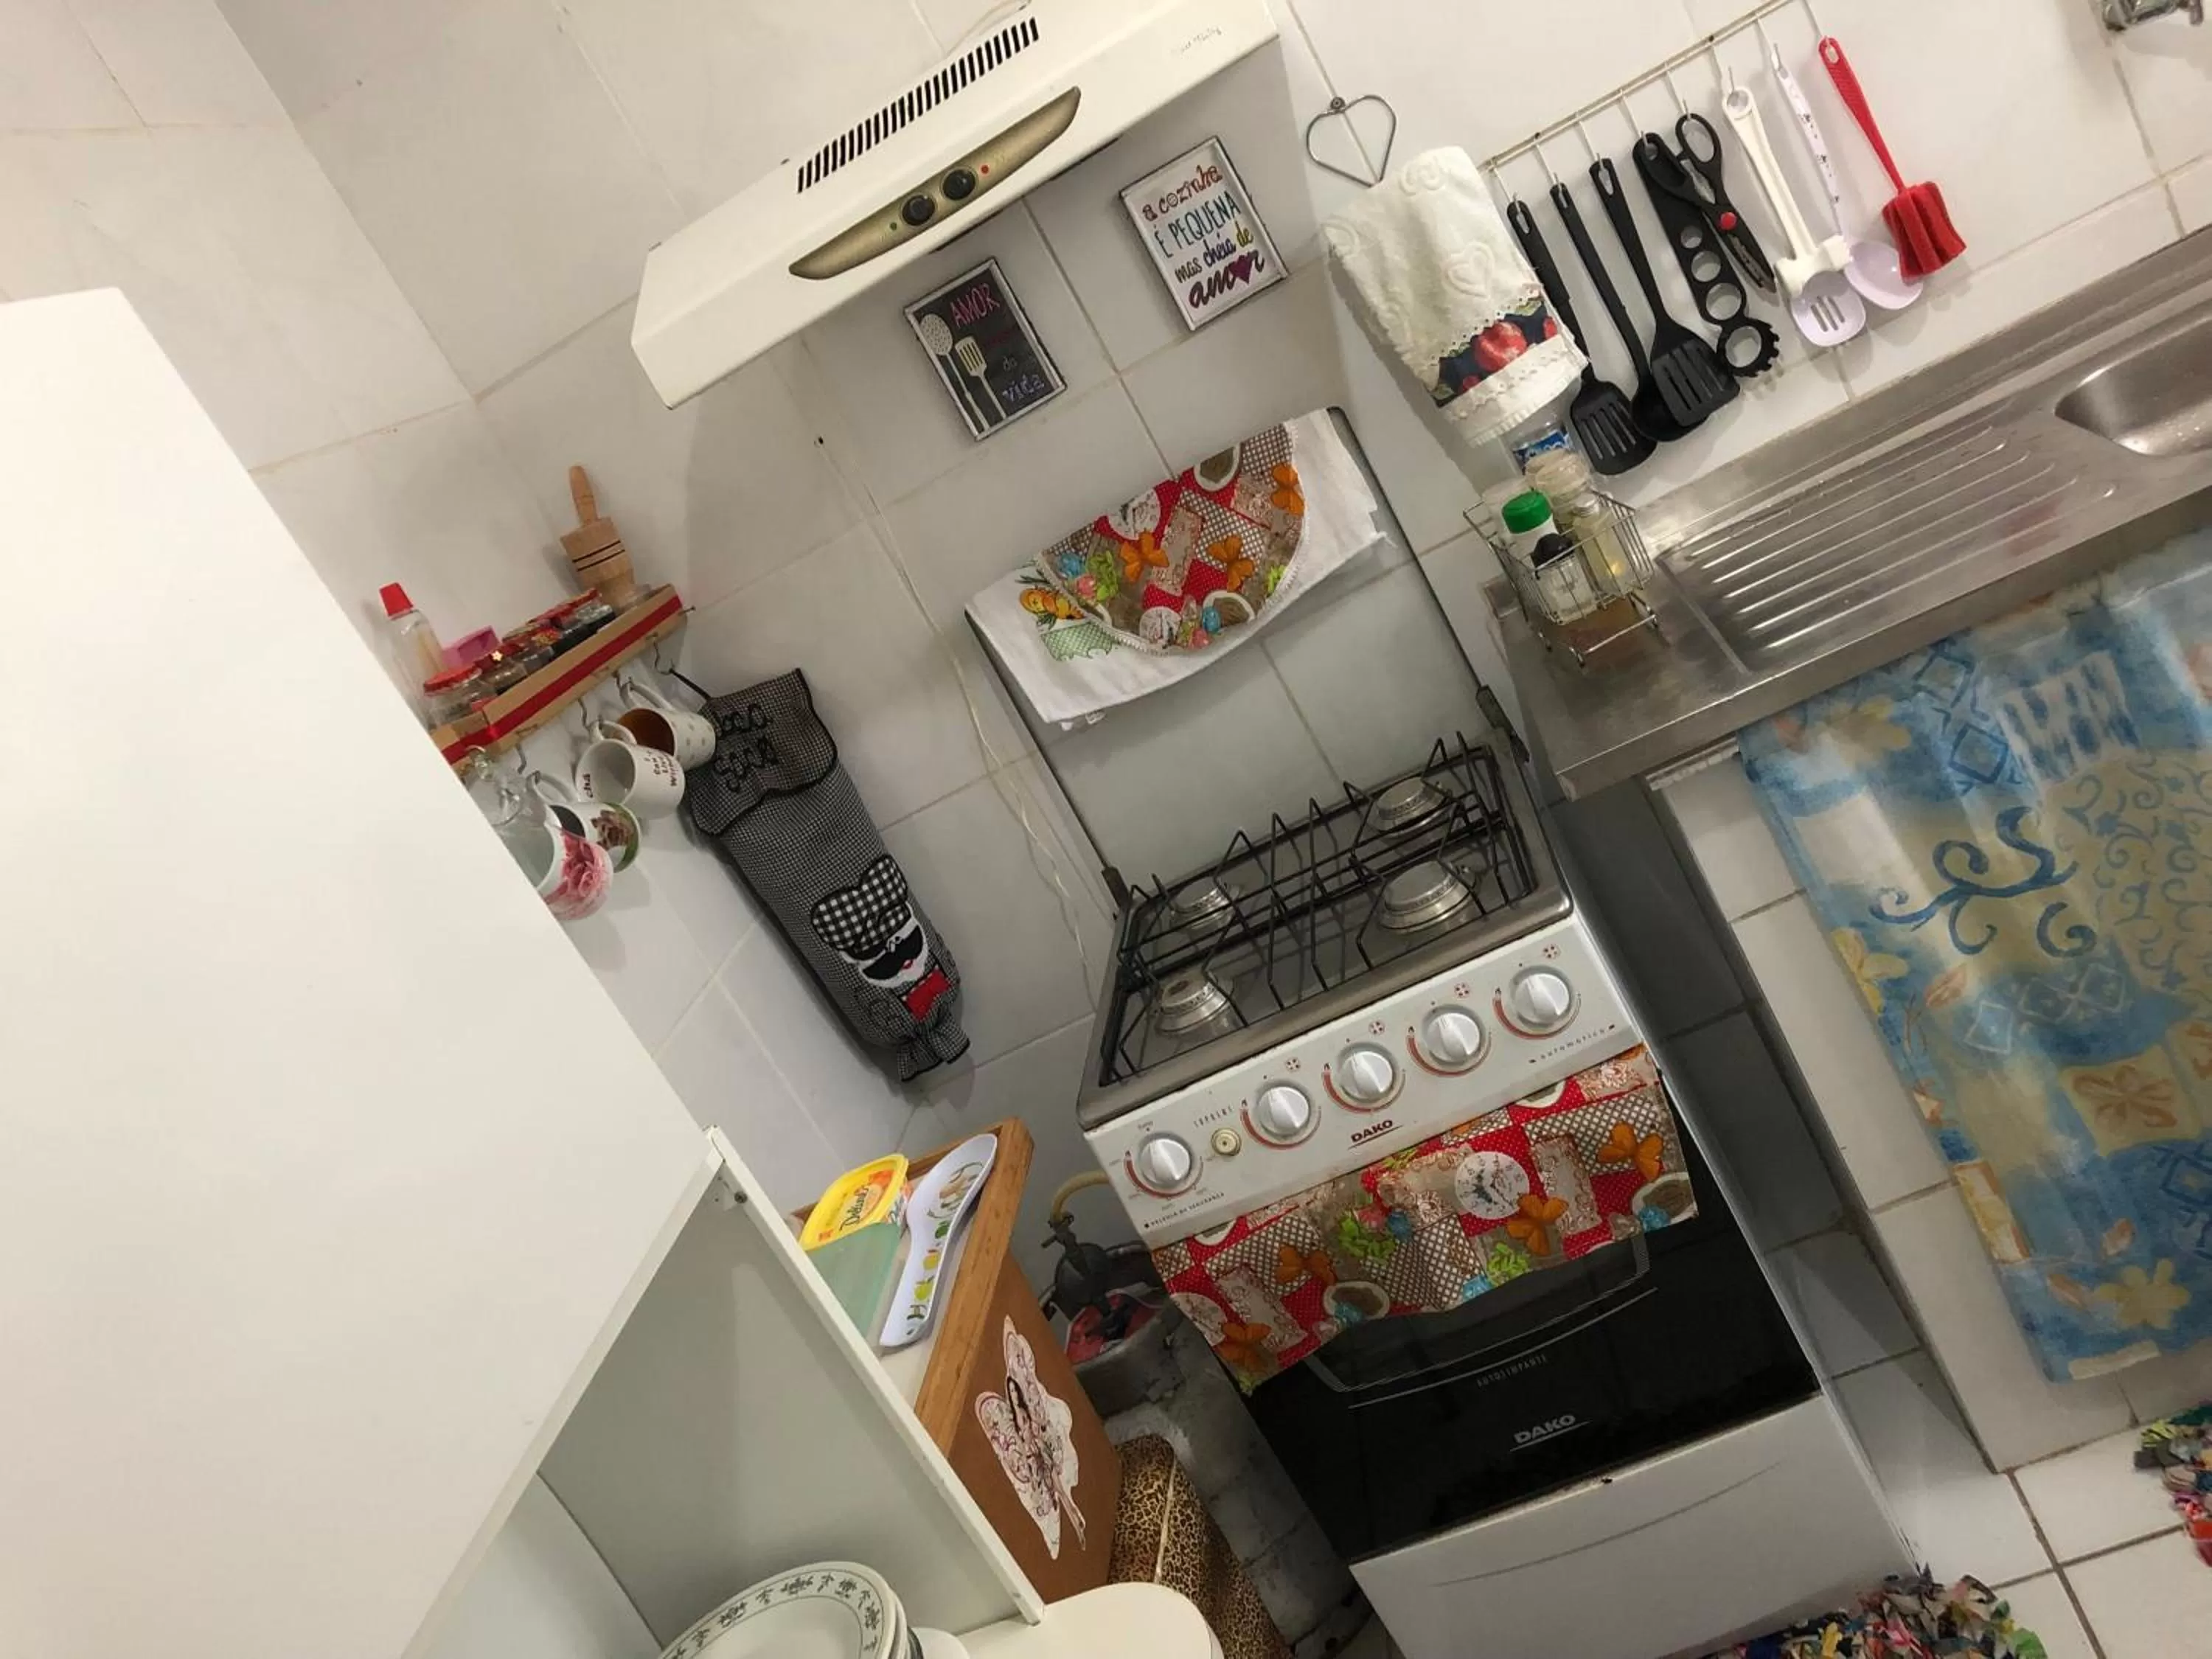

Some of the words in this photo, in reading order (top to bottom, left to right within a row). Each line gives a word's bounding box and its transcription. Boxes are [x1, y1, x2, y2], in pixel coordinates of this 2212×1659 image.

[1168, 190, 1241, 249] PEQUENA
[1175, 257, 1203, 283] mas
[1203, 232, 1236, 266] cheia
[1234, 220, 1253, 247] de
[949, 282, 1001, 327] AMOR
[1350, 1119, 1393, 1143] DAKO
[1513, 1414, 1576, 1444] DAKO
